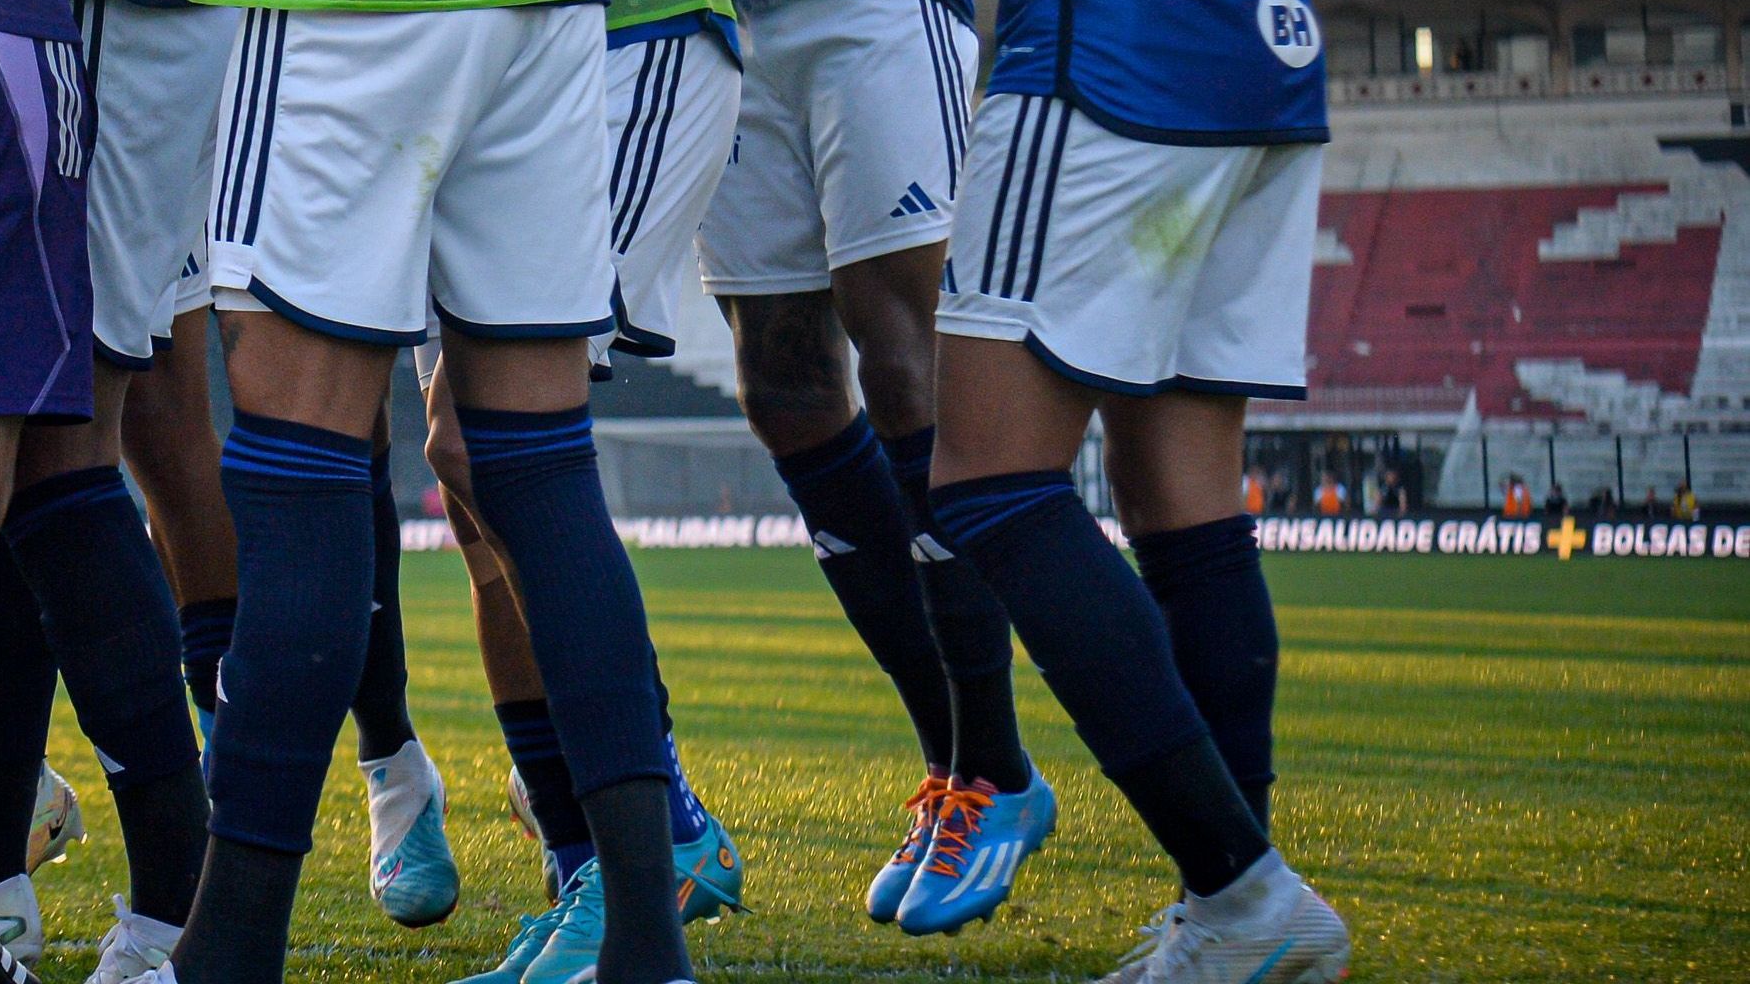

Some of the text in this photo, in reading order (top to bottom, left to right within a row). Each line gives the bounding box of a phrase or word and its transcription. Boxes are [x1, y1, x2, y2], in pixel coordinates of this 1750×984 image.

[1269, 5, 1313, 47] BH
[1437, 515, 1542, 555] GRÁTIS
[1592, 522, 1707, 557] BOLSAS
